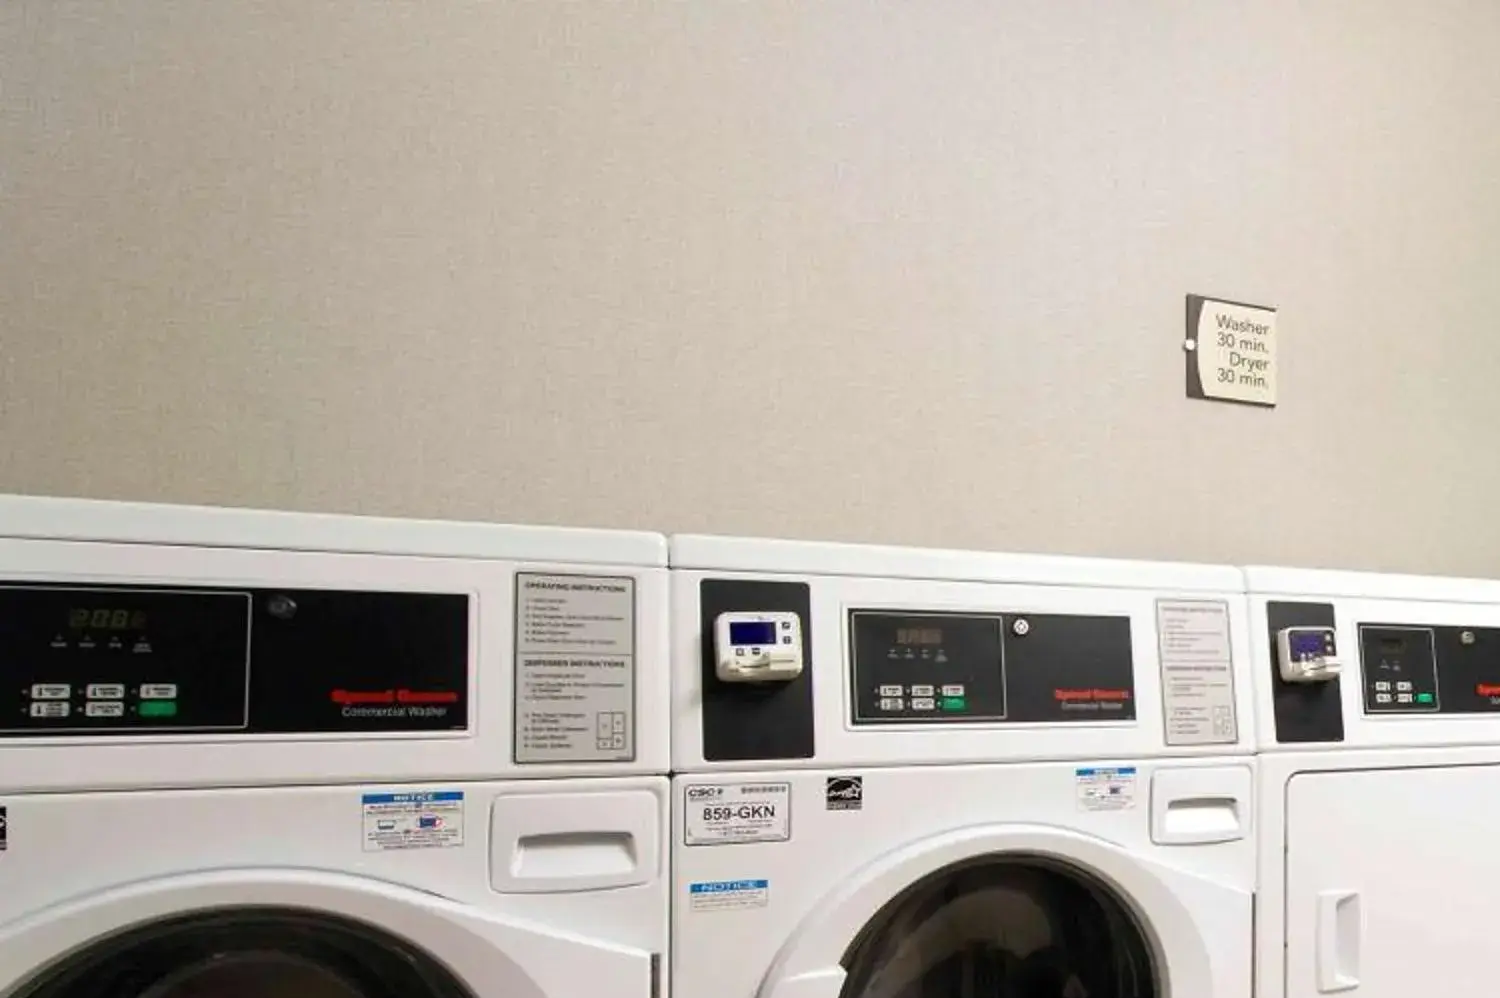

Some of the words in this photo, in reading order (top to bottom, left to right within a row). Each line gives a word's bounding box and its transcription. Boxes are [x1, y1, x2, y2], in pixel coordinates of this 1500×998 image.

[1216, 312, 1270, 335] Washer
[1217, 331, 1235, 348] 30
[1239, 338, 1270, 354] min.
[1229, 351, 1270, 373] Dryer
[1217, 368, 1235, 383] 30
[1239, 372, 1270, 390] min.
[341, 705, 406, 717] Commercial
[407, 706, 447, 717] Washer
[703, 804, 775, 821] 859-GKN
